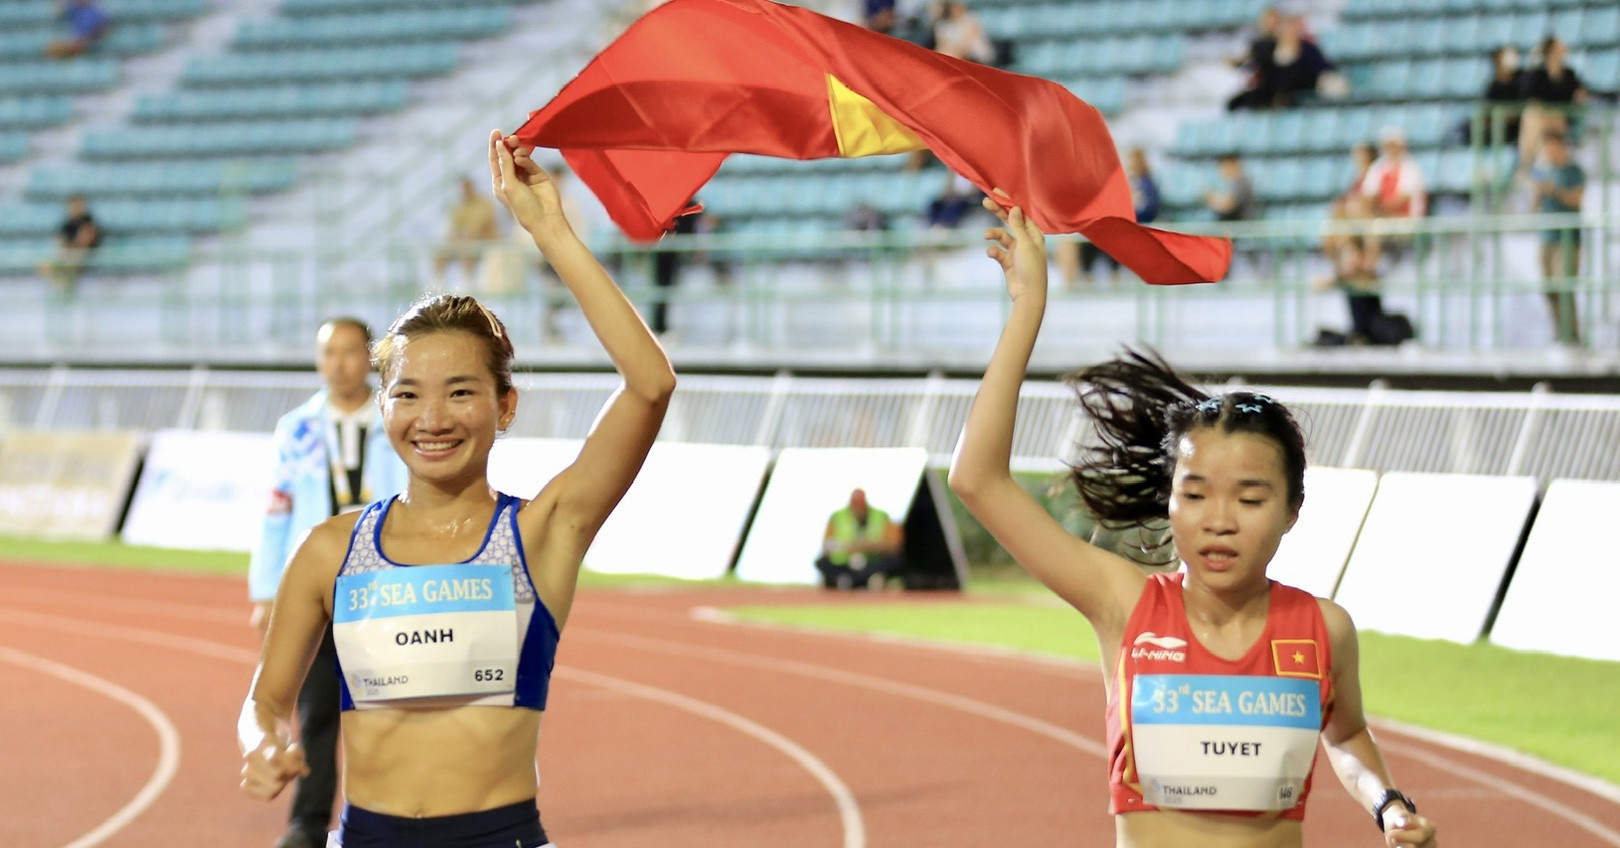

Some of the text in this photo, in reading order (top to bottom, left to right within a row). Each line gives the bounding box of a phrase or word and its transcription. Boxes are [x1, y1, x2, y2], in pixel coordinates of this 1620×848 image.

[380, 582, 417, 607] SEA
[422, 578, 493, 603] GAMES
[395, 628, 454, 646] OANH
[363, 675, 409, 687] THAILAND
[474, 669, 504, 682] 652
[1192, 690, 1232, 714] SEA
[1238, 692, 1306, 717] GAMES
[1200, 741, 1262, 756] TUYET
[1163, 785, 1217, 796] THAILAND
